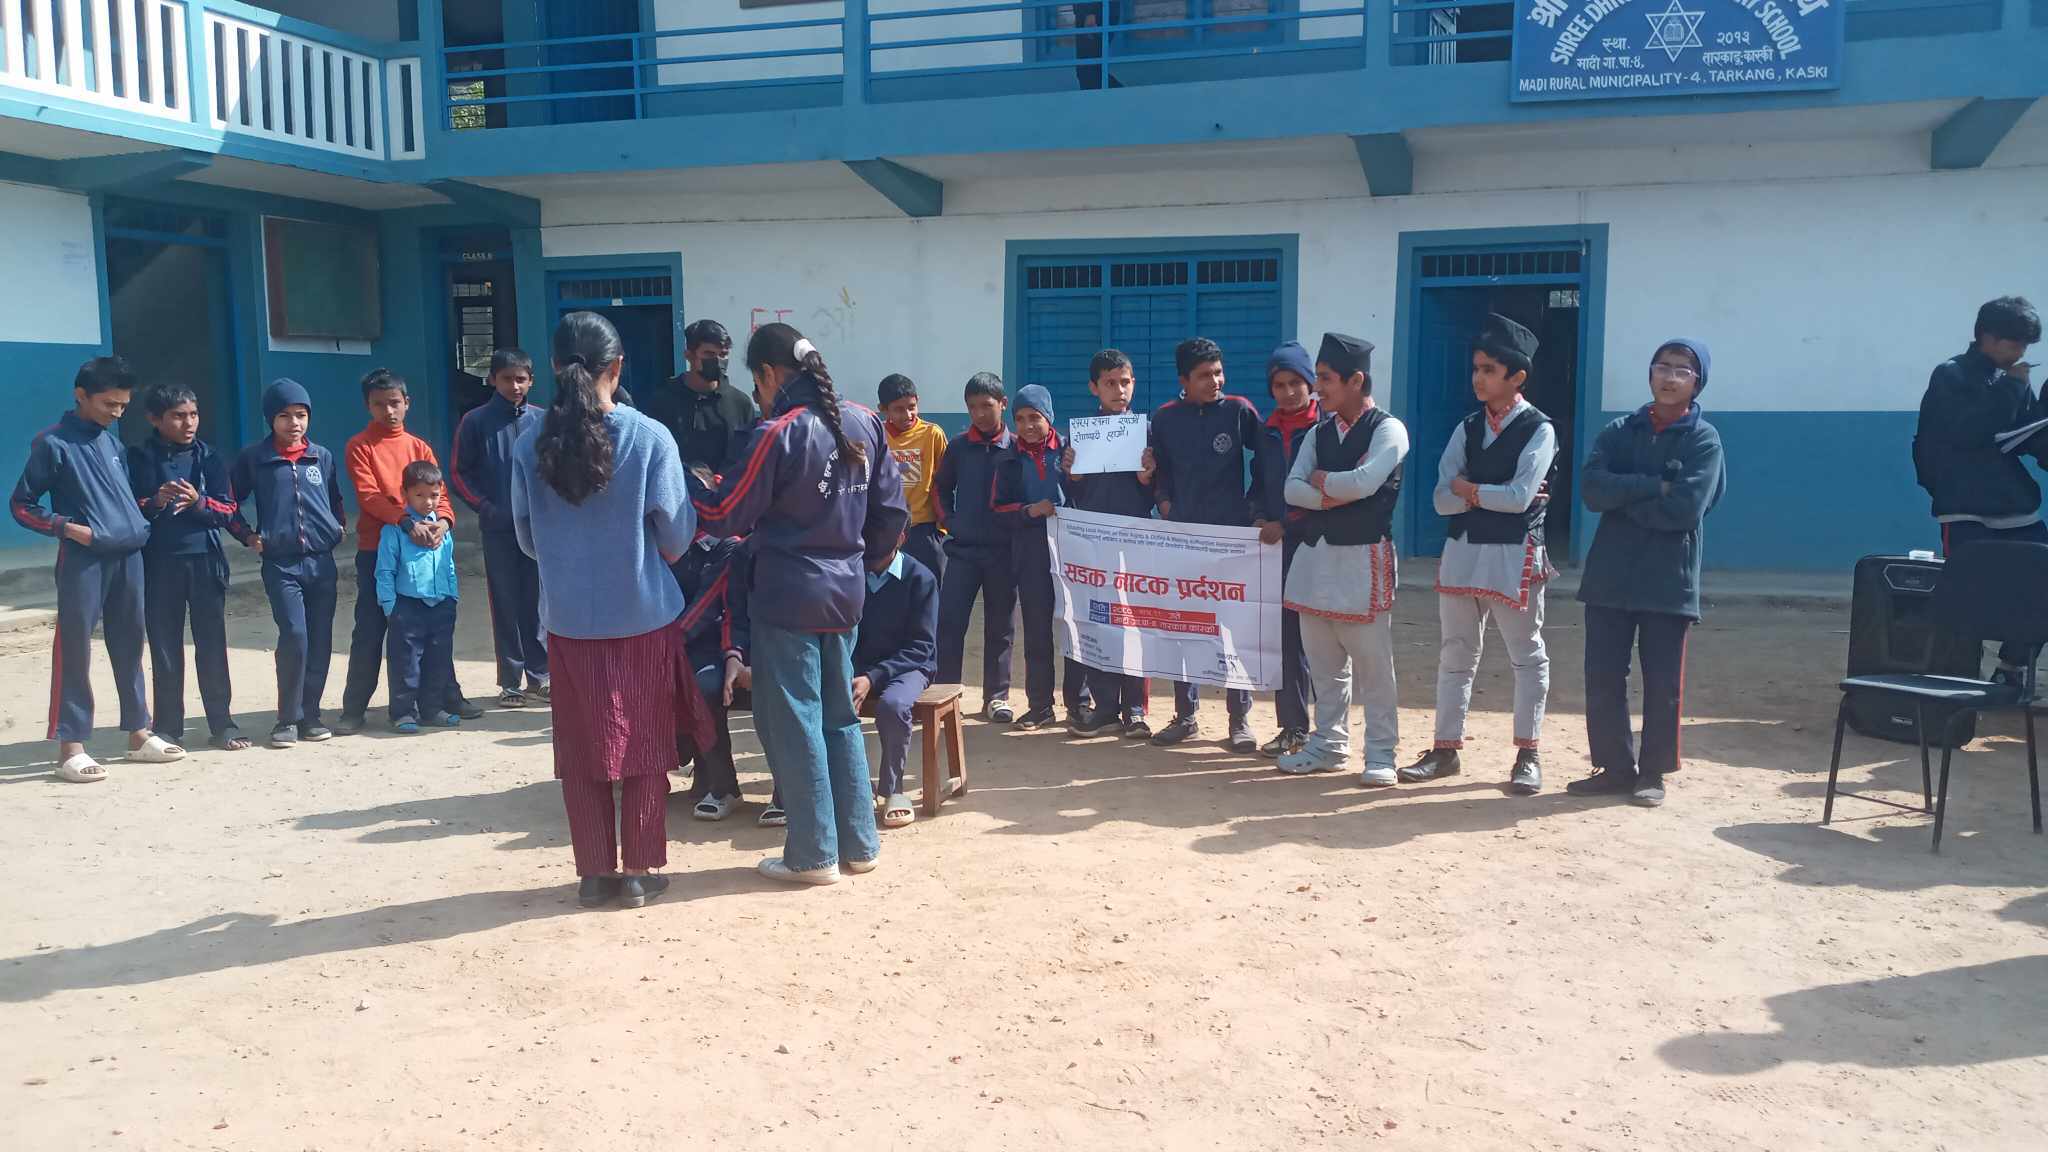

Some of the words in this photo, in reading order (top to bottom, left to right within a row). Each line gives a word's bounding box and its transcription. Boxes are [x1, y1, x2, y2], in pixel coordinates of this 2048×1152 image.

[1550, 14, 1594, 65] SHREE
[1716, 32, 1750, 46] २०१३
[1754, 1, 1801, 60] SCHOOL
[1519, 79, 1547, 92] MADI
[1550, 77, 1586, 91] RURAL
[1785, 66, 1829, 79] KASKI
[1064, 563, 1106, 588] सडक
[1113, 571, 1169, 596] नाटक
